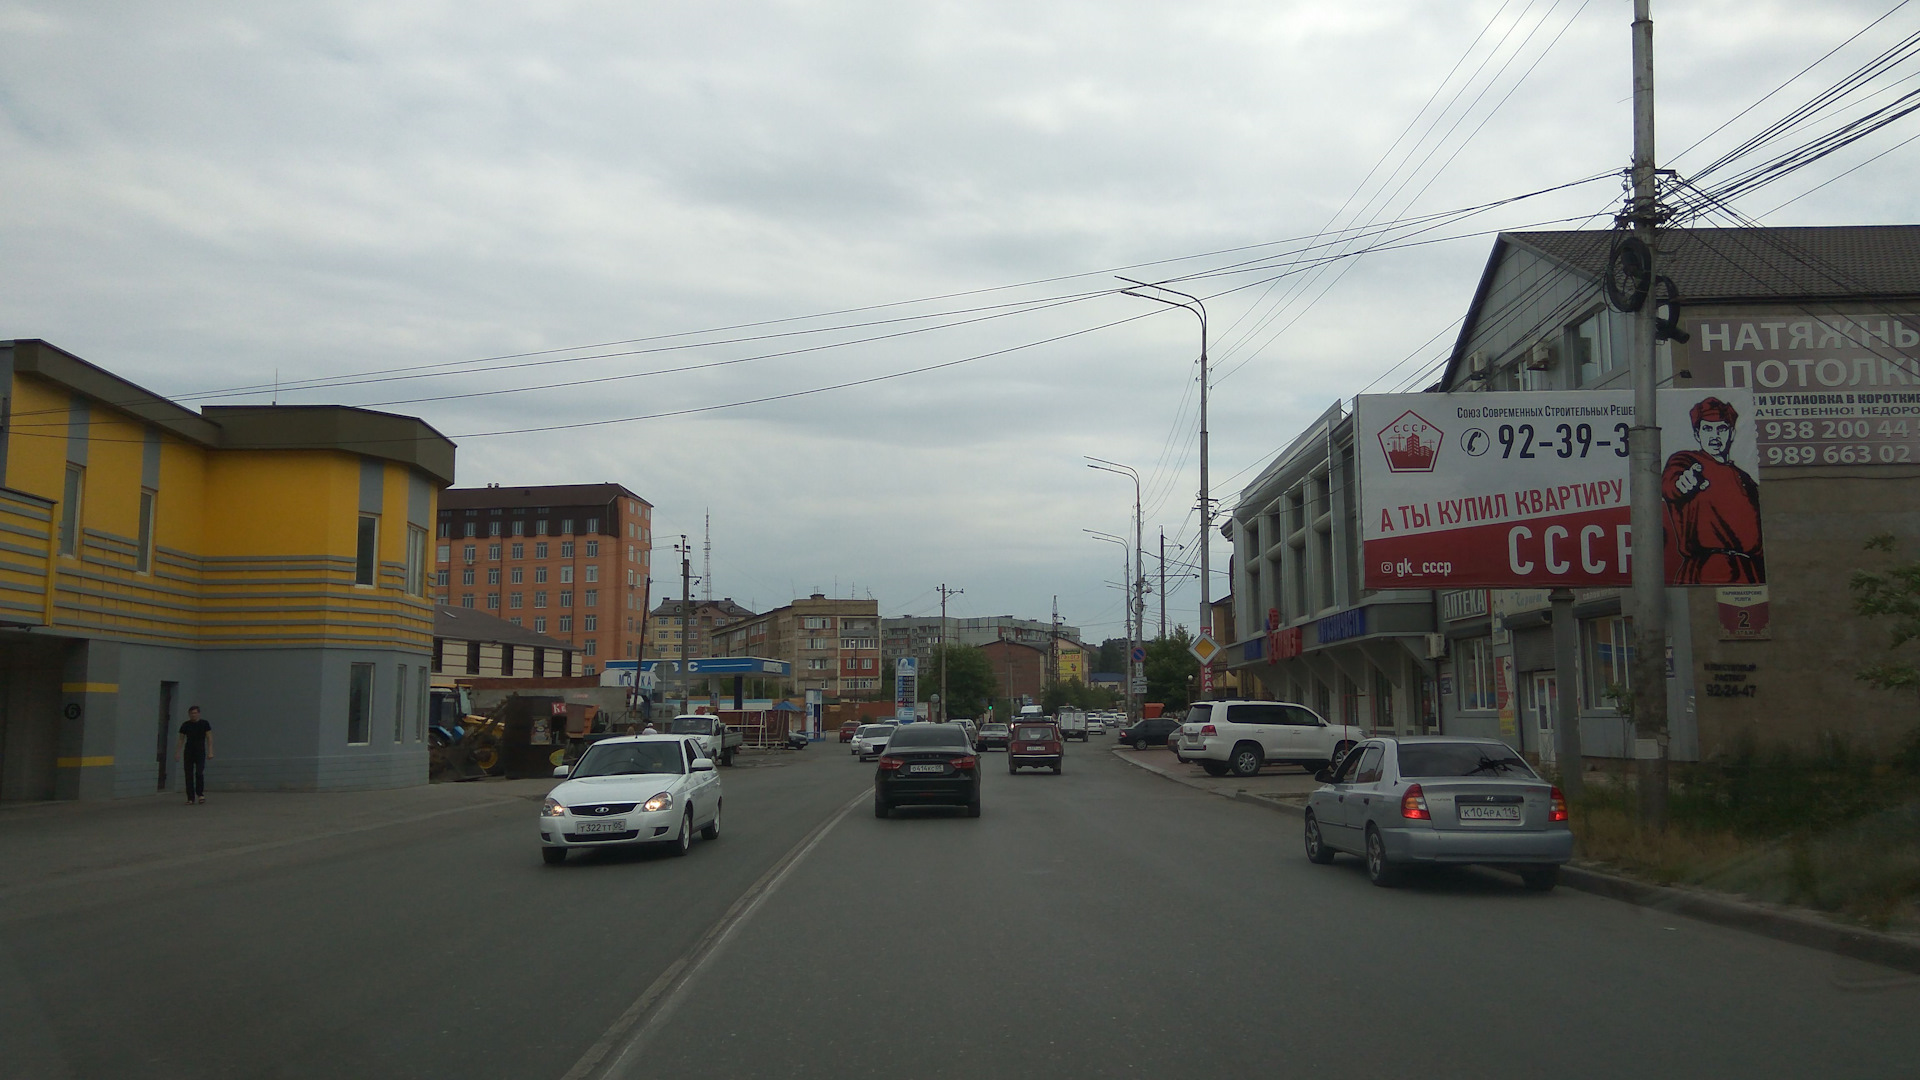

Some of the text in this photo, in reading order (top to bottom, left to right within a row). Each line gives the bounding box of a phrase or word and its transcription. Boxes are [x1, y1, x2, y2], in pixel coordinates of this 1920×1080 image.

[1759, 396, 1767, 405] И
[1770, 393, 1842, 405] УСТАНОВКА
[1847, 393, 1855, 404] В
[1756, 407, 1854, 417] АЧЕСТВЕННО!
[1394, 424, 1427, 434] СССР
[1765, 421, 1815, 440] 938
[1821, 420, 1870, 439] 200
[1876, 420, 1911, 438] 44
[1498, 422, 1630, 458] 92-39-3
[1767, 446, 1816, 465] 989
[1823, 445, 1872, 464] 663
[1879, 445, 1912, 464] 02
[1381, 478, 1623, 532] А ТЫ КУПИЛ КВАРТИРУ
[1444, 588, 1486, 619] АПТЕКА
[1738, 611, 1750, 628] 2
[618, 674, 652, 687] МОКА
